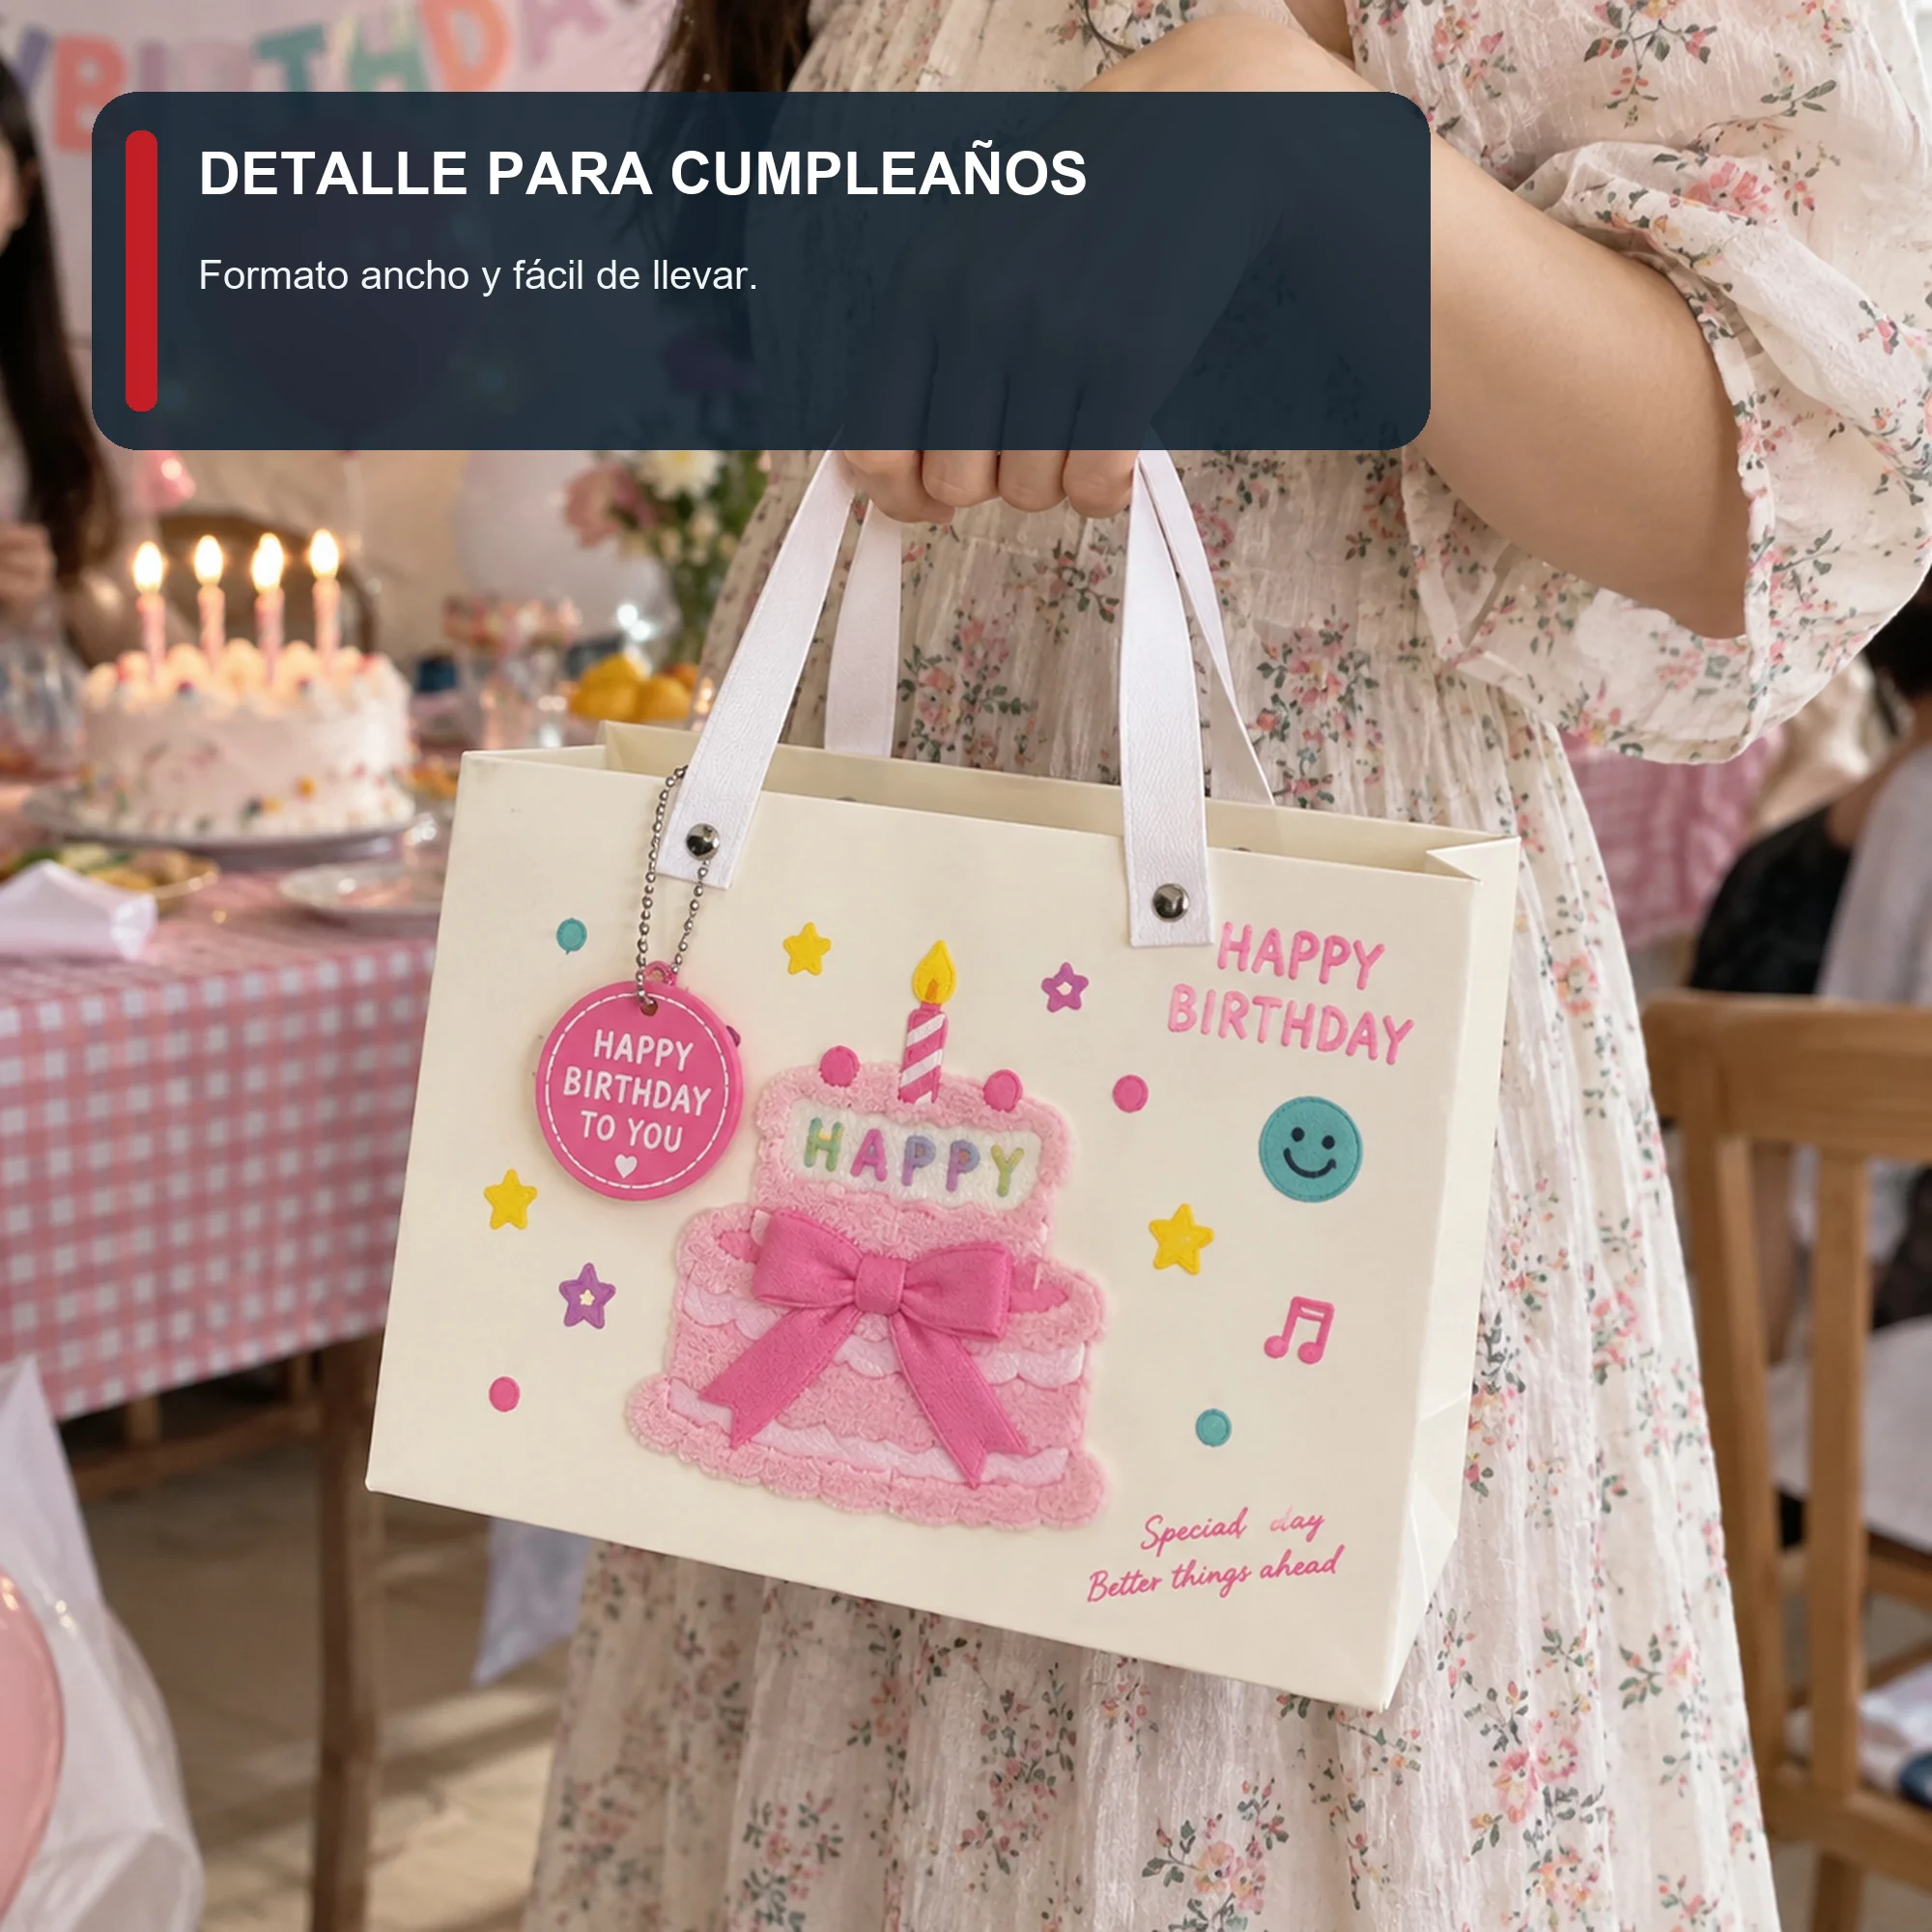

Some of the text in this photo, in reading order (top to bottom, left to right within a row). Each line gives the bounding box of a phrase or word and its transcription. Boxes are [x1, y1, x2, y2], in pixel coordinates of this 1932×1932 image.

[1217, 921, 1386, 990] HAPPY
[593, 1029, 694, 1071] HAPPY
[1168, 983, 1414, 1065] BIRTHDAY
[563, 1065, 712, 1117] BIRTHDAY
[581, 1110, 683, 1152] TO YOU
[804, 1117, 1025, 1197] HAPPY
[1269, 1506, 1325, 1543] day
[1087, 1543, 1346, 1603] Better things ahead
